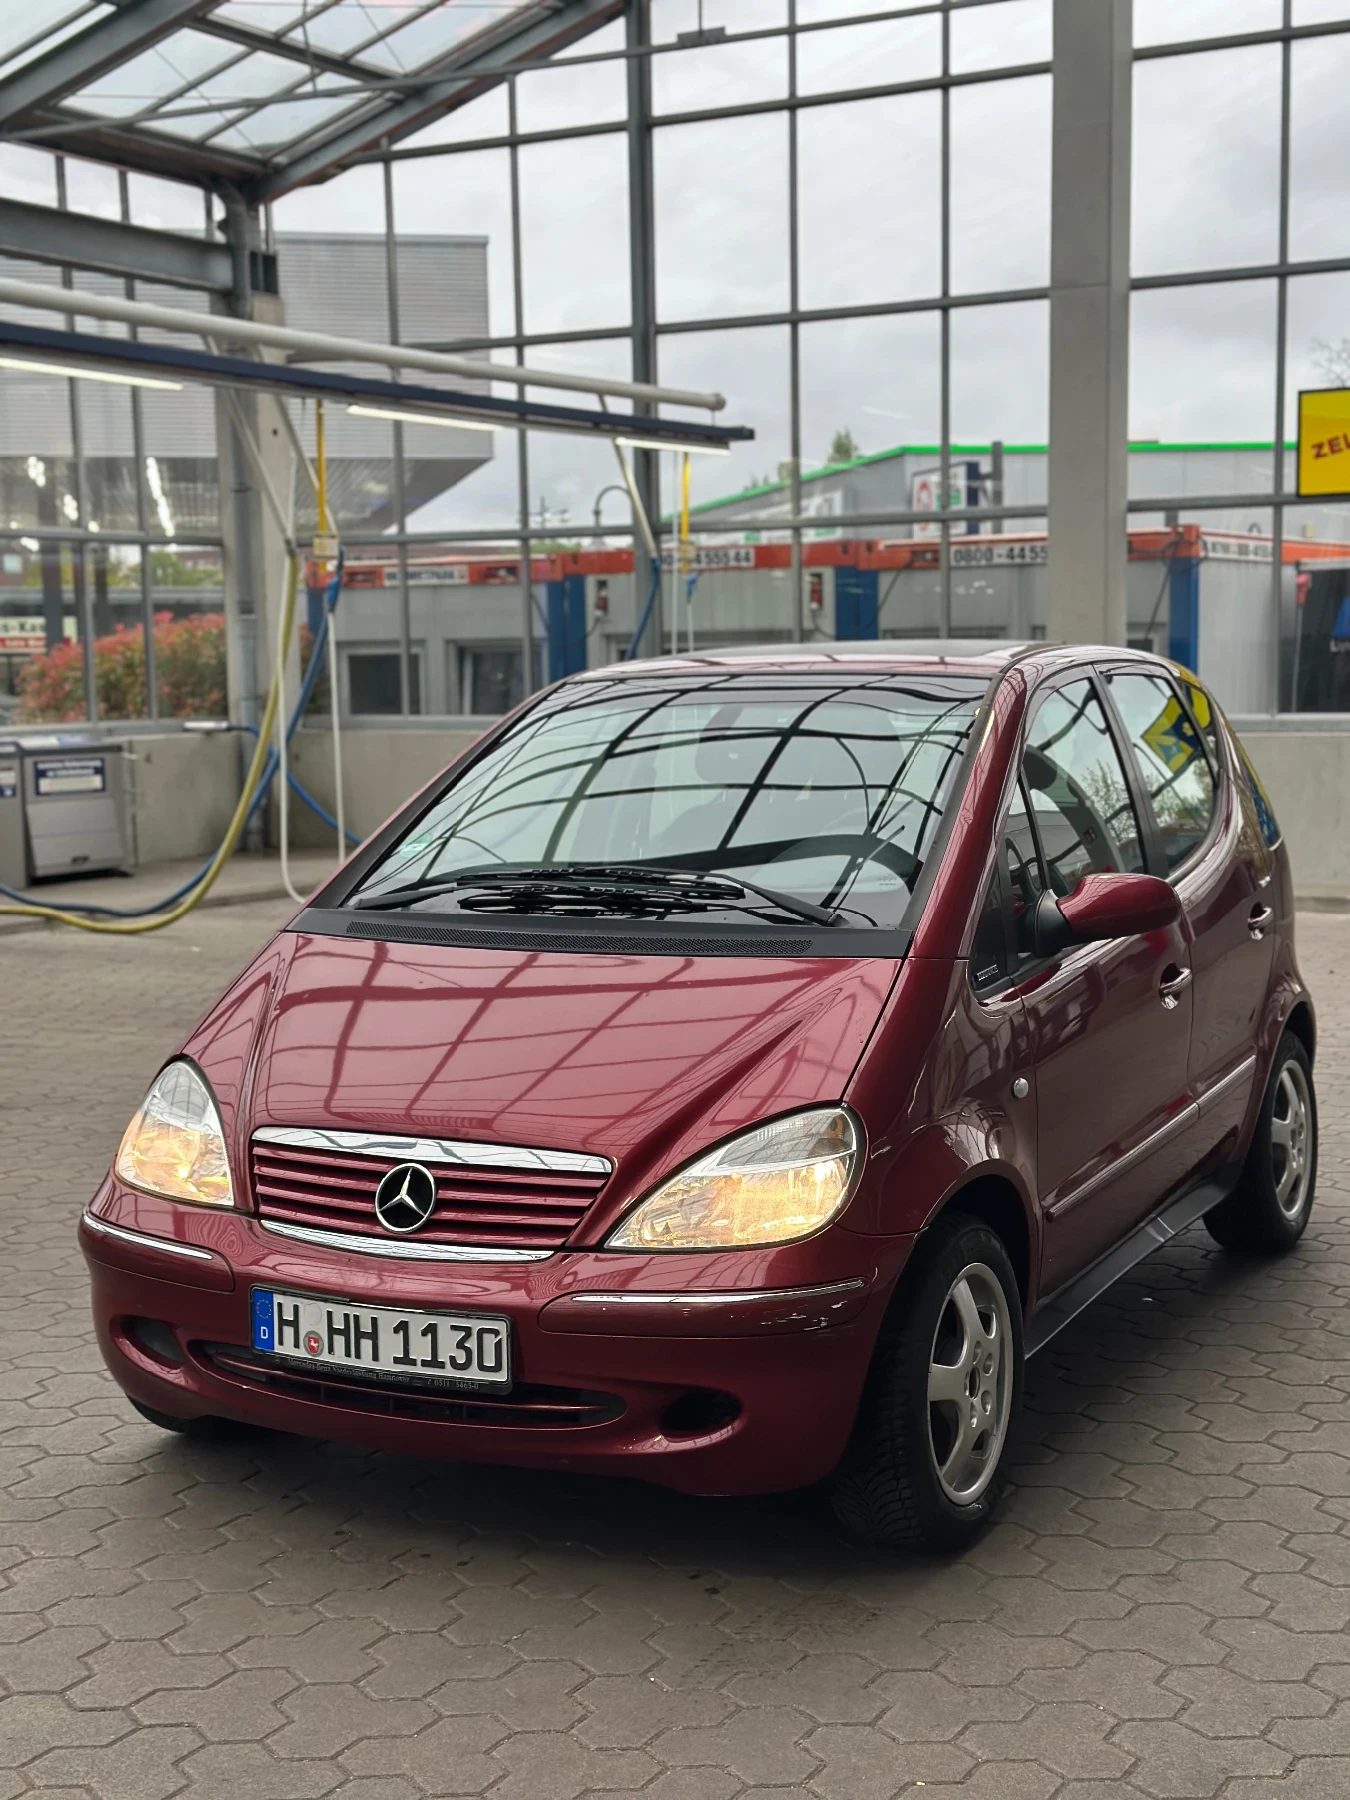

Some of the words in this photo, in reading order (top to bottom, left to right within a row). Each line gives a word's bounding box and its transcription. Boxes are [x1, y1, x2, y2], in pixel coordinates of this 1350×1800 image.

[260, 1326, 269, 1340] D
[276, 1301, 300, 1349] H
[326, 1309, 379, 1362] HH
[392, 1319, 503, 1373] 1130
